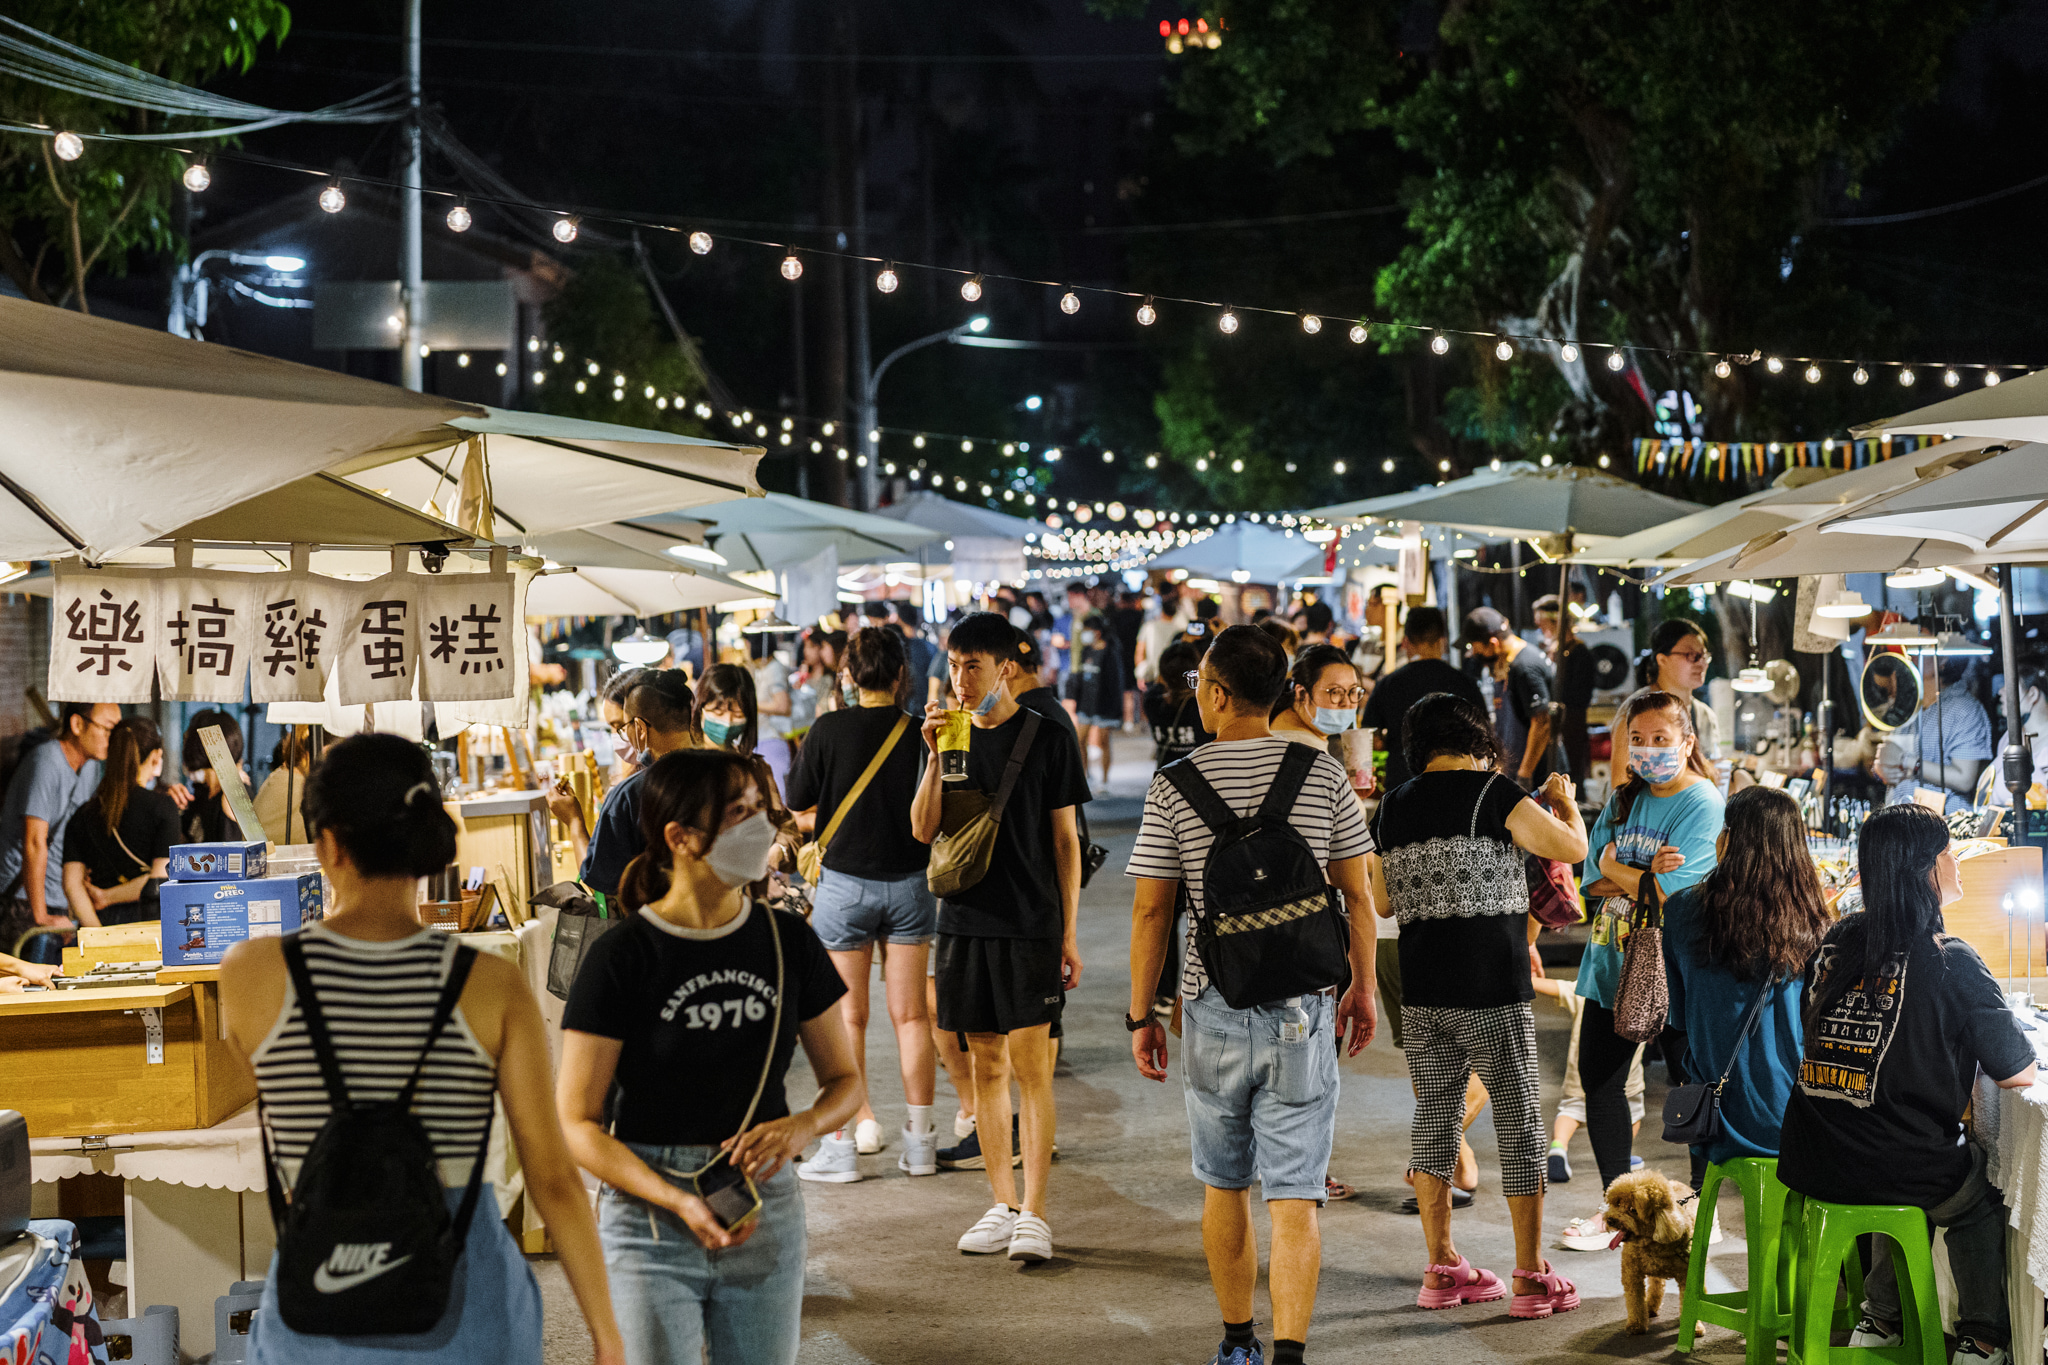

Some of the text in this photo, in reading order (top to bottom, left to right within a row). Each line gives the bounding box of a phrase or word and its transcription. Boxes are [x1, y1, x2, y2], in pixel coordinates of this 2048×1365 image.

[65, 588, 504, 679] 樂搞雞蛋糕
[213, 889, 245, 900] OREO
[684, 995, 767, 1030] 1976
[1841, 1024, 1850, 1036] 21
[1866, 1029, 1877, 1041] 43
[327, 1242, 392, 1272] NIKE
